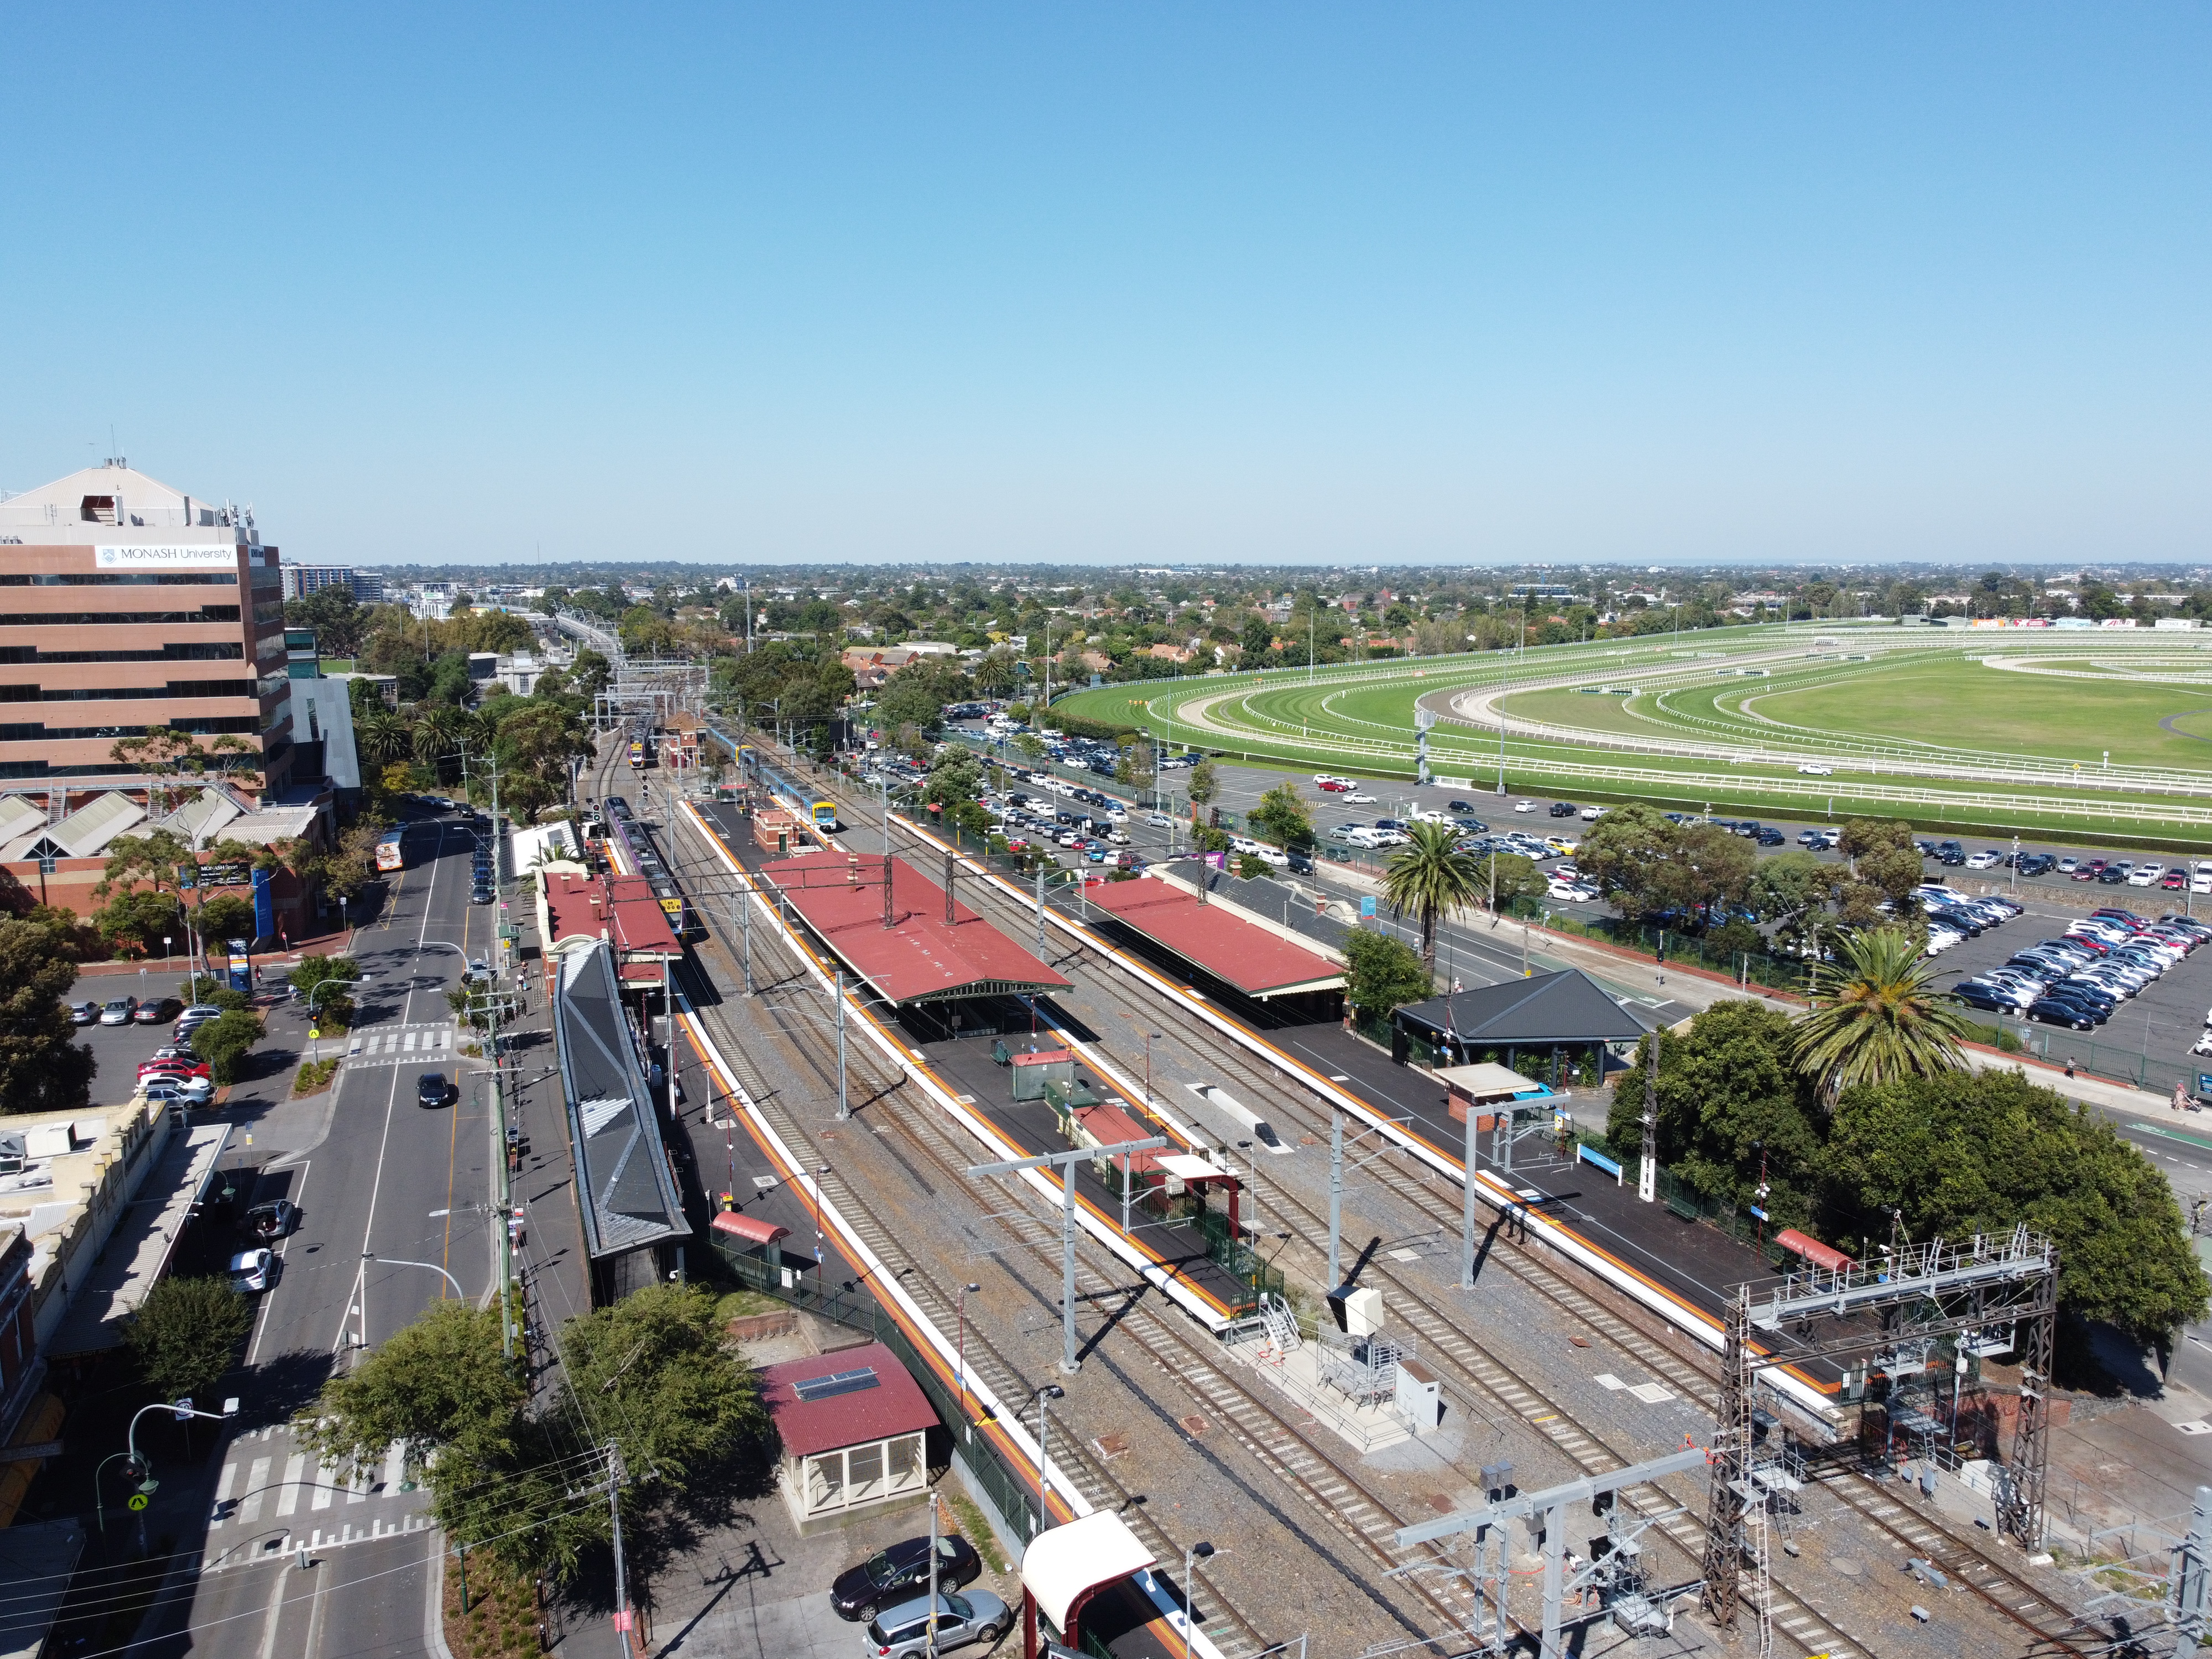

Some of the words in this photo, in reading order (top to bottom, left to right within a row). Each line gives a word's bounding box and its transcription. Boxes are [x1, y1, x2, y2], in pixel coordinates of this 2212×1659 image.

[121, 549, 177, 559] MONASH
[180, 548, 232, 560] University
[51, 1353, 81, 1361] DRAGON
